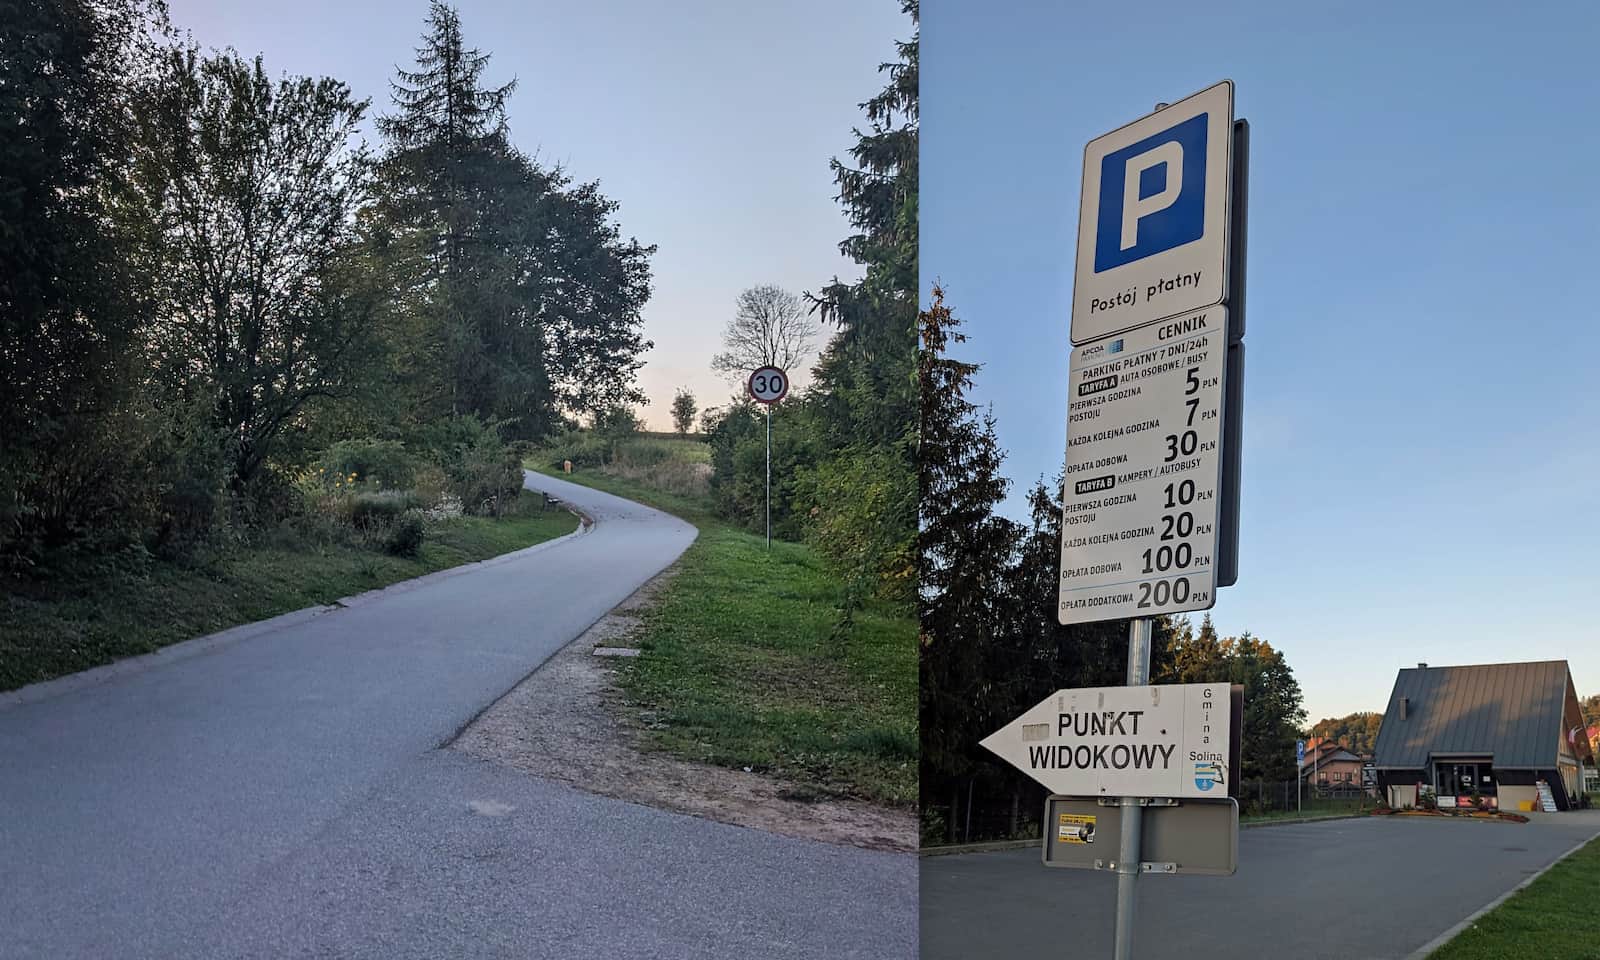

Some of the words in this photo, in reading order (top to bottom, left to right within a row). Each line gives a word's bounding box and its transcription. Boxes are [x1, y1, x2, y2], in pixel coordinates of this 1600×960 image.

[1120, 141, 1183, 251] P
[1091, 287, 1137, 314] Postój
[1147, 271, 1202, 301] płatny
[1158, 314, 1207, 340] CENNIK
[1082, 362, 1121, 380] PARKING
[1123, 351, 1157, 370] PŁATNY
[1160, 350, 1165, 360] 7
[1168, 336, 1208, 357] DNI/24h
[755, 375, 783, 394] 30
[1081, 379, 1108, 393] TARYFA
[1120, 373, 1139, 383] AUTA
[1142, 360, 1180, 378] OSOBOWE
[1187, 352, 1208, 365] BUSY
[1185, 367, 1199, 395] 5
[1202, 377, 1218, 388] PLN
[1070, 393, 1106, 411] PIERWSZA
[1108, 387, 1141, 402] GODZINA
[1186, 398, 1200, 426] 7
[1202, 409, 1217, 420] PLN
[1069, 410, 1100, 423] POSTOJU
[1093, 426, 1123, 441] KOLEJNA
[1126, 420, 1159, 434] GODZINA
[1164, 430, 1198, 462] 30
[1200, 441, 1215, 452] PLN
[1067, 463, 1093, 473] OPŁATA
[1096, 455, 1128, 467] DOBOWA
[1077, 482, 1106, 493] TARYFA
[1118, 469, 1153, 484] KAMPERY
[1160, 458, 1201, 475] AUTOBUSY
[1065, 498, 1102, 513] PIERWSZA
[1104, 493, 1136, 507] GODZINA
[1164, 480, 1195, 508] 10
[1198, 490, 1213, 501] PLN
[1065, 514, 1096, 525] POSTOJU
[1160, 512, 1193, 541] 20
[1197, 524, 1211, 535] PLN
[1089, 531, 1119, 545] KOLEJNA
[1121, 527, 1154, 540] GODZINA
[1062, 567, 1088, 578] OPŁATA
[1091, 562, 1122, 575] DOBOWA
[1142, 542, 1192, 574] 100
[1195, 556, 1210, 566] PLN
[1061, 597, 1086, 609] OPŁATA
[1088, 593, 1133, 607] DODATKOWA
[1137, 577, 1189, 608] 200
[1193, 592, 1208, 602] PLN
[1058, 711, 1144, 737] PUNKT
[1203, 688, 1212, 744] Gmina
[1029, 744, 1175, 769] WIDOKOWY
[1189, 751, 1222, 761] Solina
